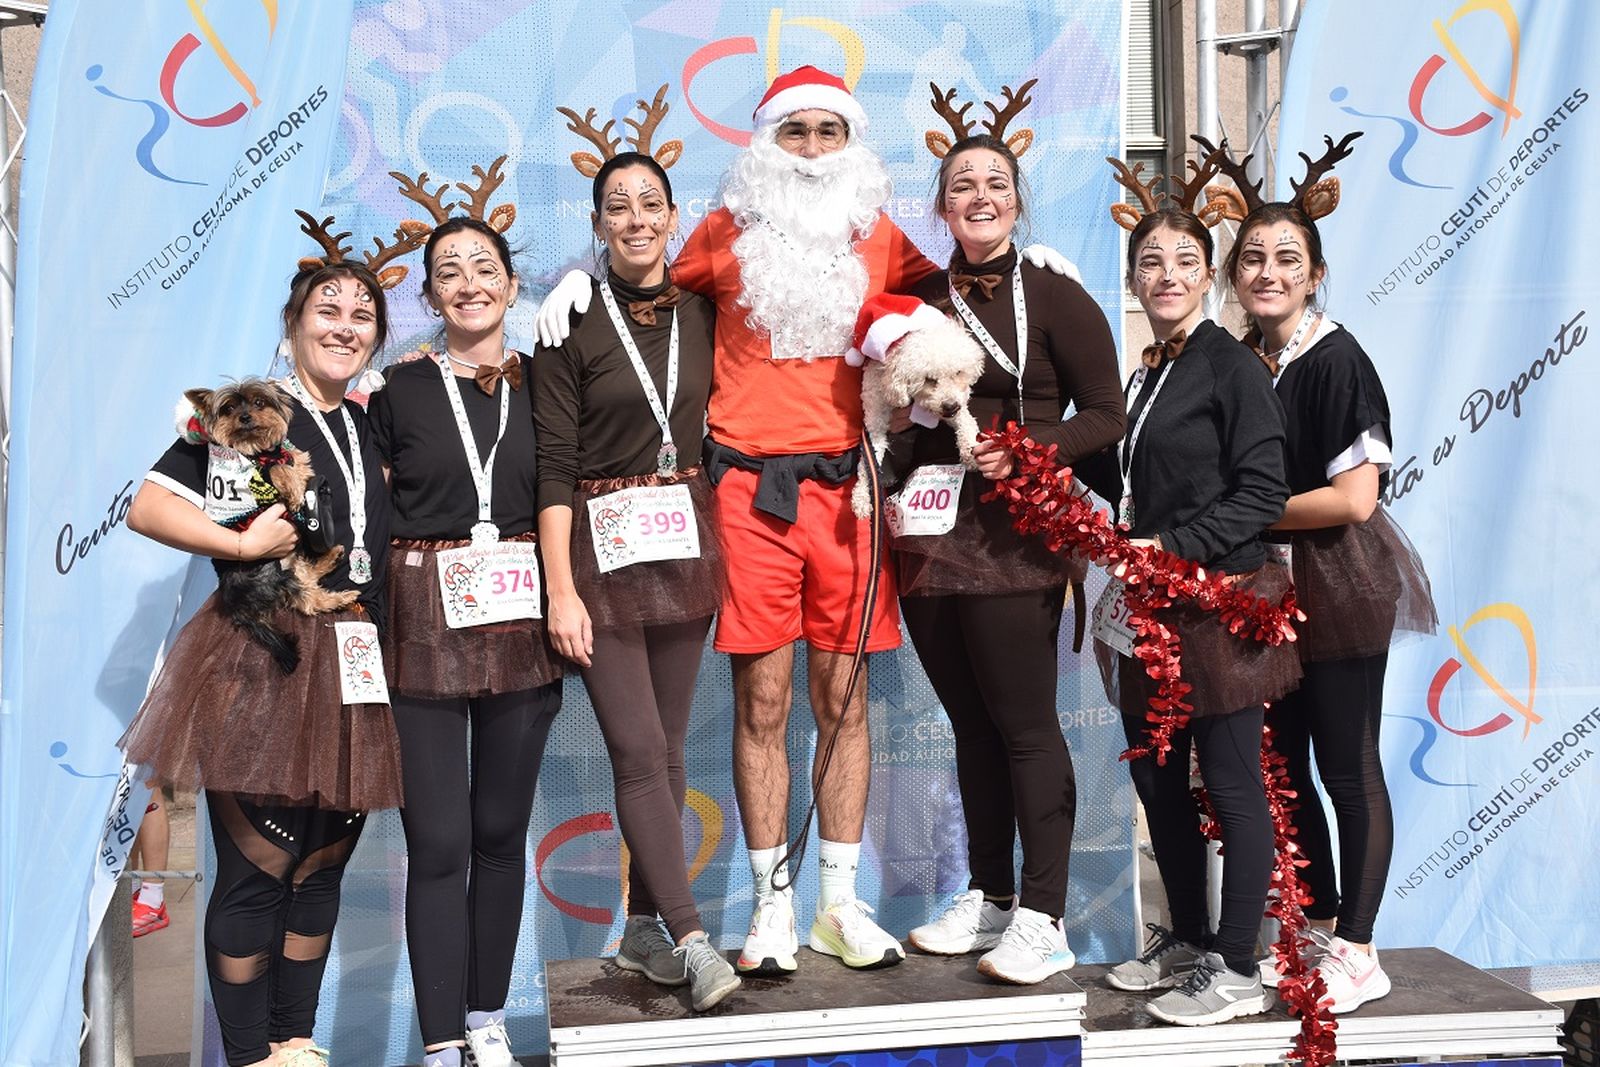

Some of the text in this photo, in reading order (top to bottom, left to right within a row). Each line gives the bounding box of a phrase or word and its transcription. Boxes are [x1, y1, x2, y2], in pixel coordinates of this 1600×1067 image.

[107, 235, 191, 309] INSTITUTO
[229, 159, 248, 188] DE
[245, 85, 328, 166] DEPORTES
[161, 251, 200, 290] CIUDAD
[251, 171, 268, 190] DE
[269, 141, 304, 173] CEUTA
[1366, 88, 1589, 306] INSTITUTO CEUTÍ DE DEPORTES
[1415, 248, 1454, 285] CIUDAD
[1510, 177, 1525, 192] DE
[1524, 142, 1561, 176] CEUTA
[1433, 435, 1456, 466] es
[1460, 310, 1588, 434] Deporte
[638, 511, 687, 535] 399
[907, 489, 951, 511] 400
[490, 569, 534, 594] 374
[1394, 830, 1469, 900] INSTITUTO
[1468, 786, 1515, 832] CEUTÍ
[1510, 768, 1538, 794] DE
[1445, 844, 1483, 879] CIUDAD
[1541, 776, 1559, 793] DE
[1558, 748, 1594, 779] CEUTA
